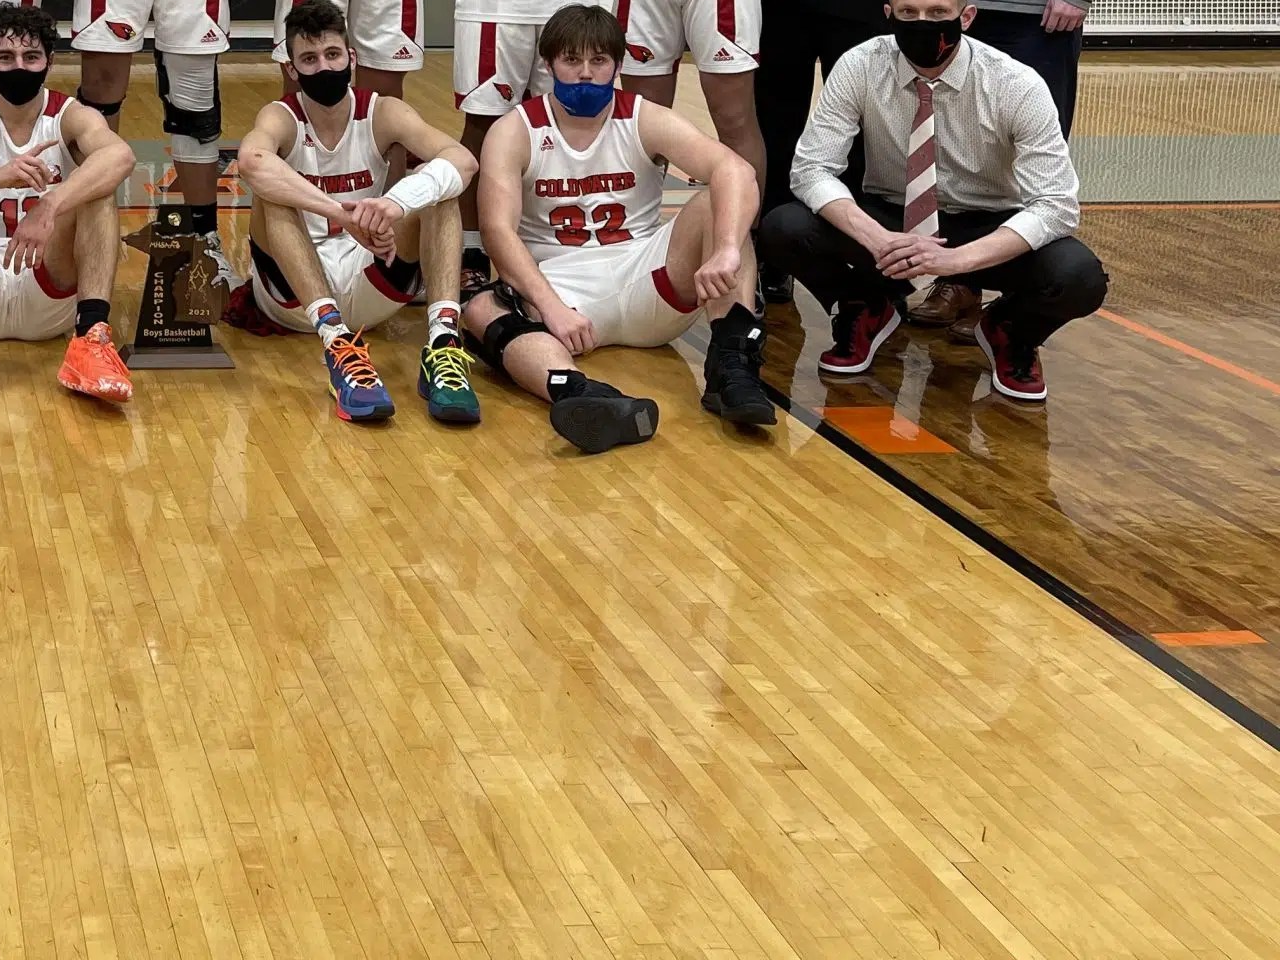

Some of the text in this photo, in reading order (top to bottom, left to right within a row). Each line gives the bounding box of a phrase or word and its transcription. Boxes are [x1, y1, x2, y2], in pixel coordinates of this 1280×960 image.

[534, 172, 635, 198] COLDWATER
[549, 202, 633, 247] 32
[153, 271, 165, 325] CHAMPION
[188, 308, 210, 316] 2021
[143, 328, 206, 338] Boys Basketball
